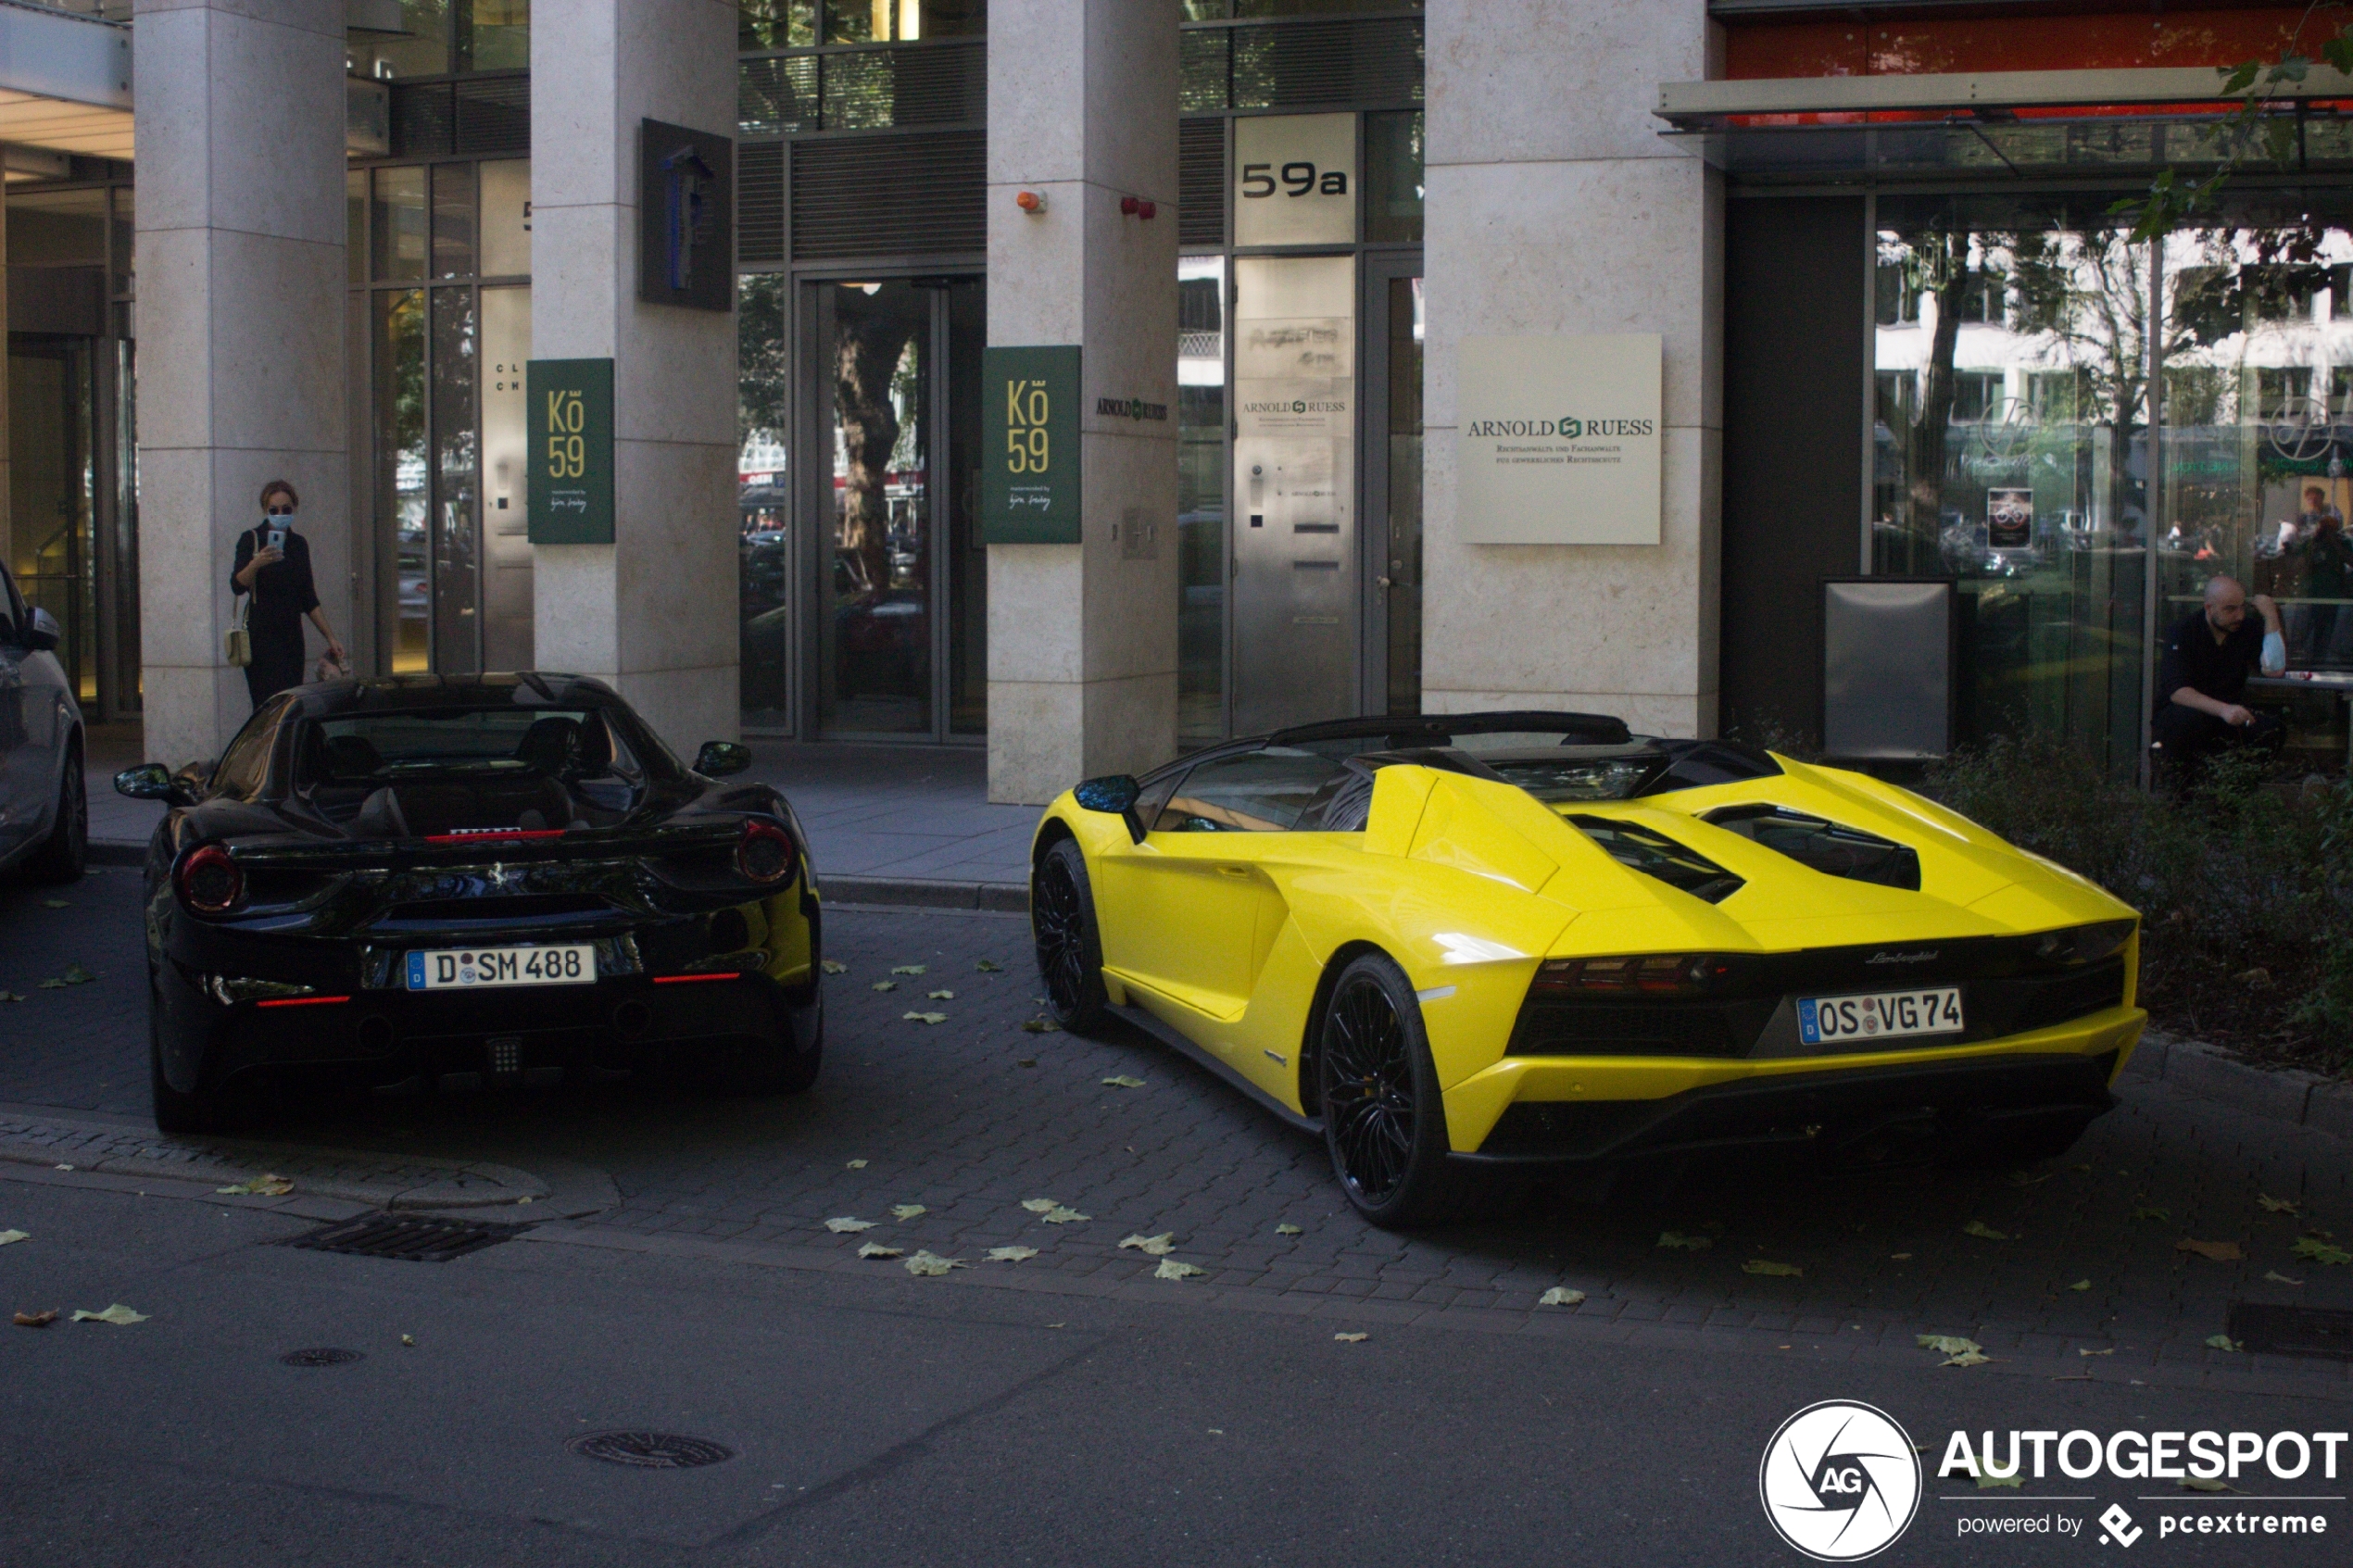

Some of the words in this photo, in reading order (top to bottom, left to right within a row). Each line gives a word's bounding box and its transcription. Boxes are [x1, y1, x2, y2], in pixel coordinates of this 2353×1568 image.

[1242, 160, 1348, 199] 59a
[1096, 397, 1131, 417] ARNOLD
[1142, 403, 1168, 420] RUESS
[1243, 402, 1291, 413] ARNOLD
[1308, 402, 1346, 413] RUESS
[1467, 420, 1555, 437] ARNOLD
[1587, 419, 1653, 436] RUESS
[547, 434, 585, 478] 59
[1007, 427, 1050, 473] 59
[413, 973, 422, 983] D
[436, 955, 457, 983] D
[478, 952, 518, 981] SM
[525, 949, 582, 979] 488
[1807, 1024, 1815, 1035] D
[1819, 1001, 1858, 1036] OS
